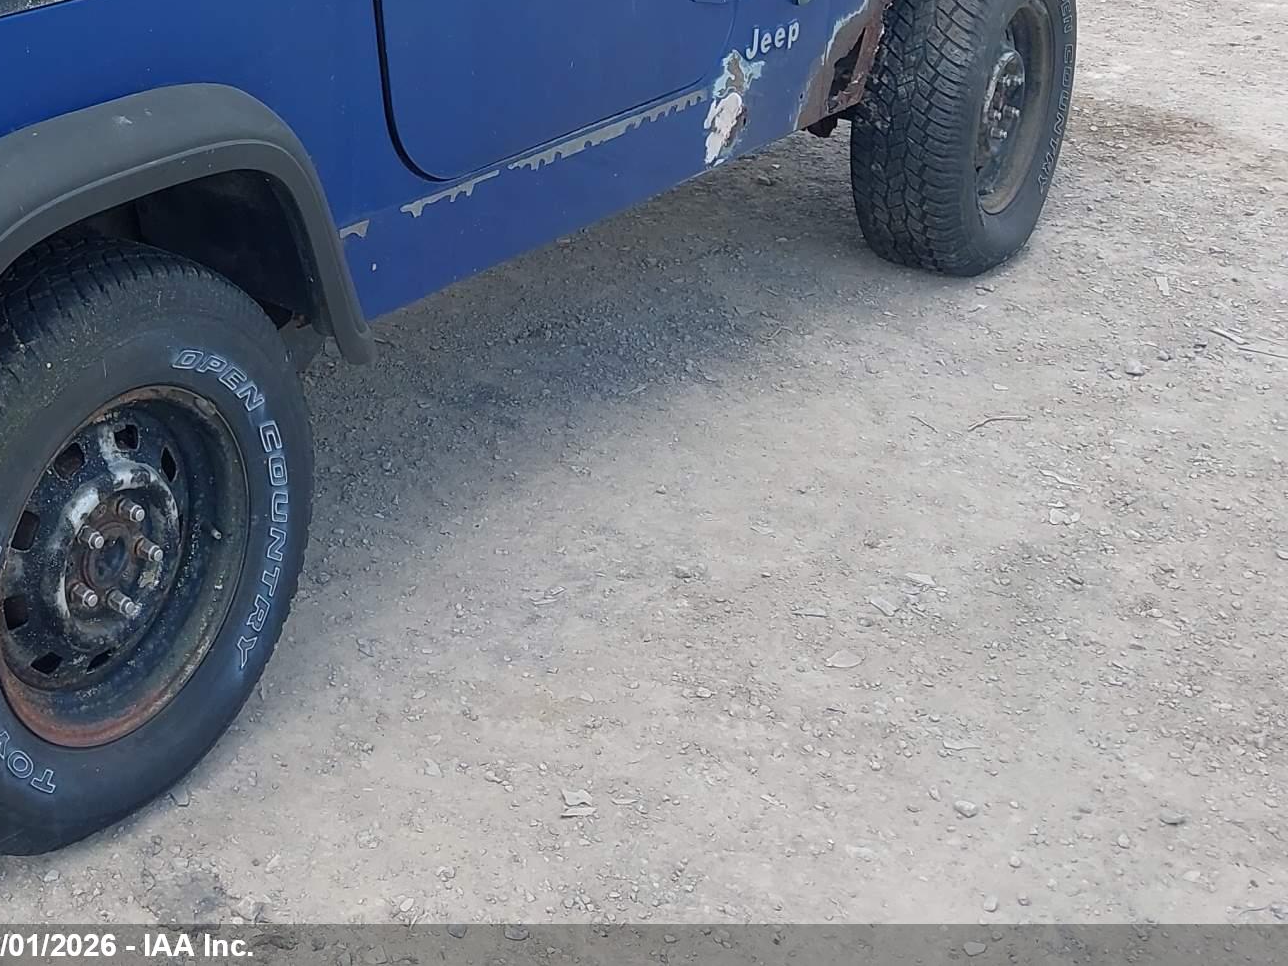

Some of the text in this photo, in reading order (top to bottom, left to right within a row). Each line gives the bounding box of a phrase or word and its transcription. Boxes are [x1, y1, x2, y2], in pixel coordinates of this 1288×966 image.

[745, 19, 800, 60] Jeep
[171, 348, 290, 669] OPEN COUNTRY
